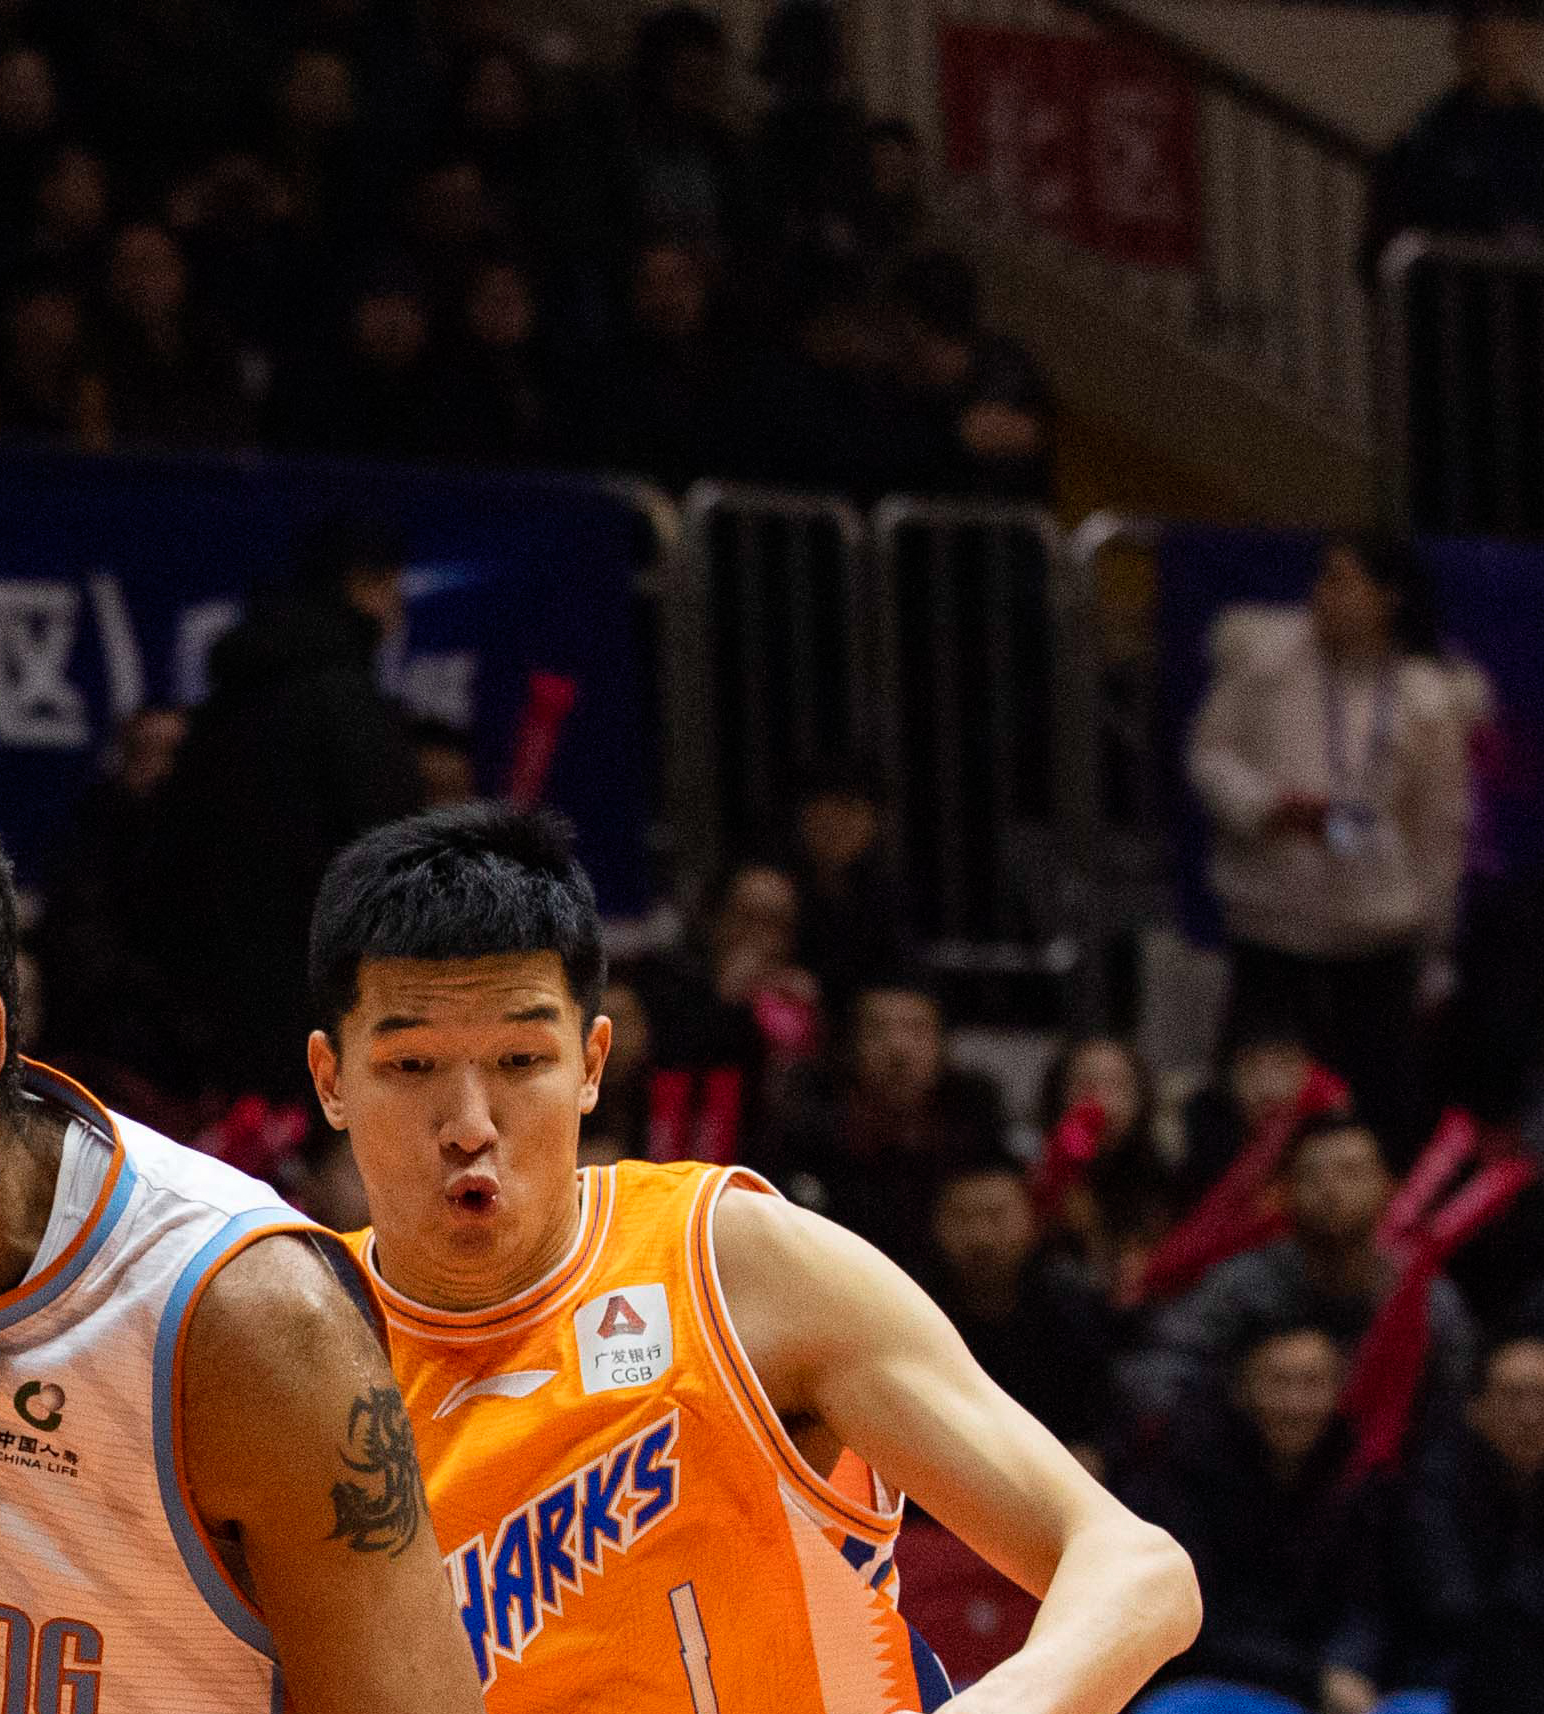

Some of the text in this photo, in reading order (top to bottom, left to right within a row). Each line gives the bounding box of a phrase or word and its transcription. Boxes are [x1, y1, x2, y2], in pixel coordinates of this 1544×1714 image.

[595, 1343, 662, 1369] 广发银行
[611, 1365, 654, 1385] CGB
[46, 1461, 80, 1479] LIFE
[442, 1408, 680, 1696] HARKS
